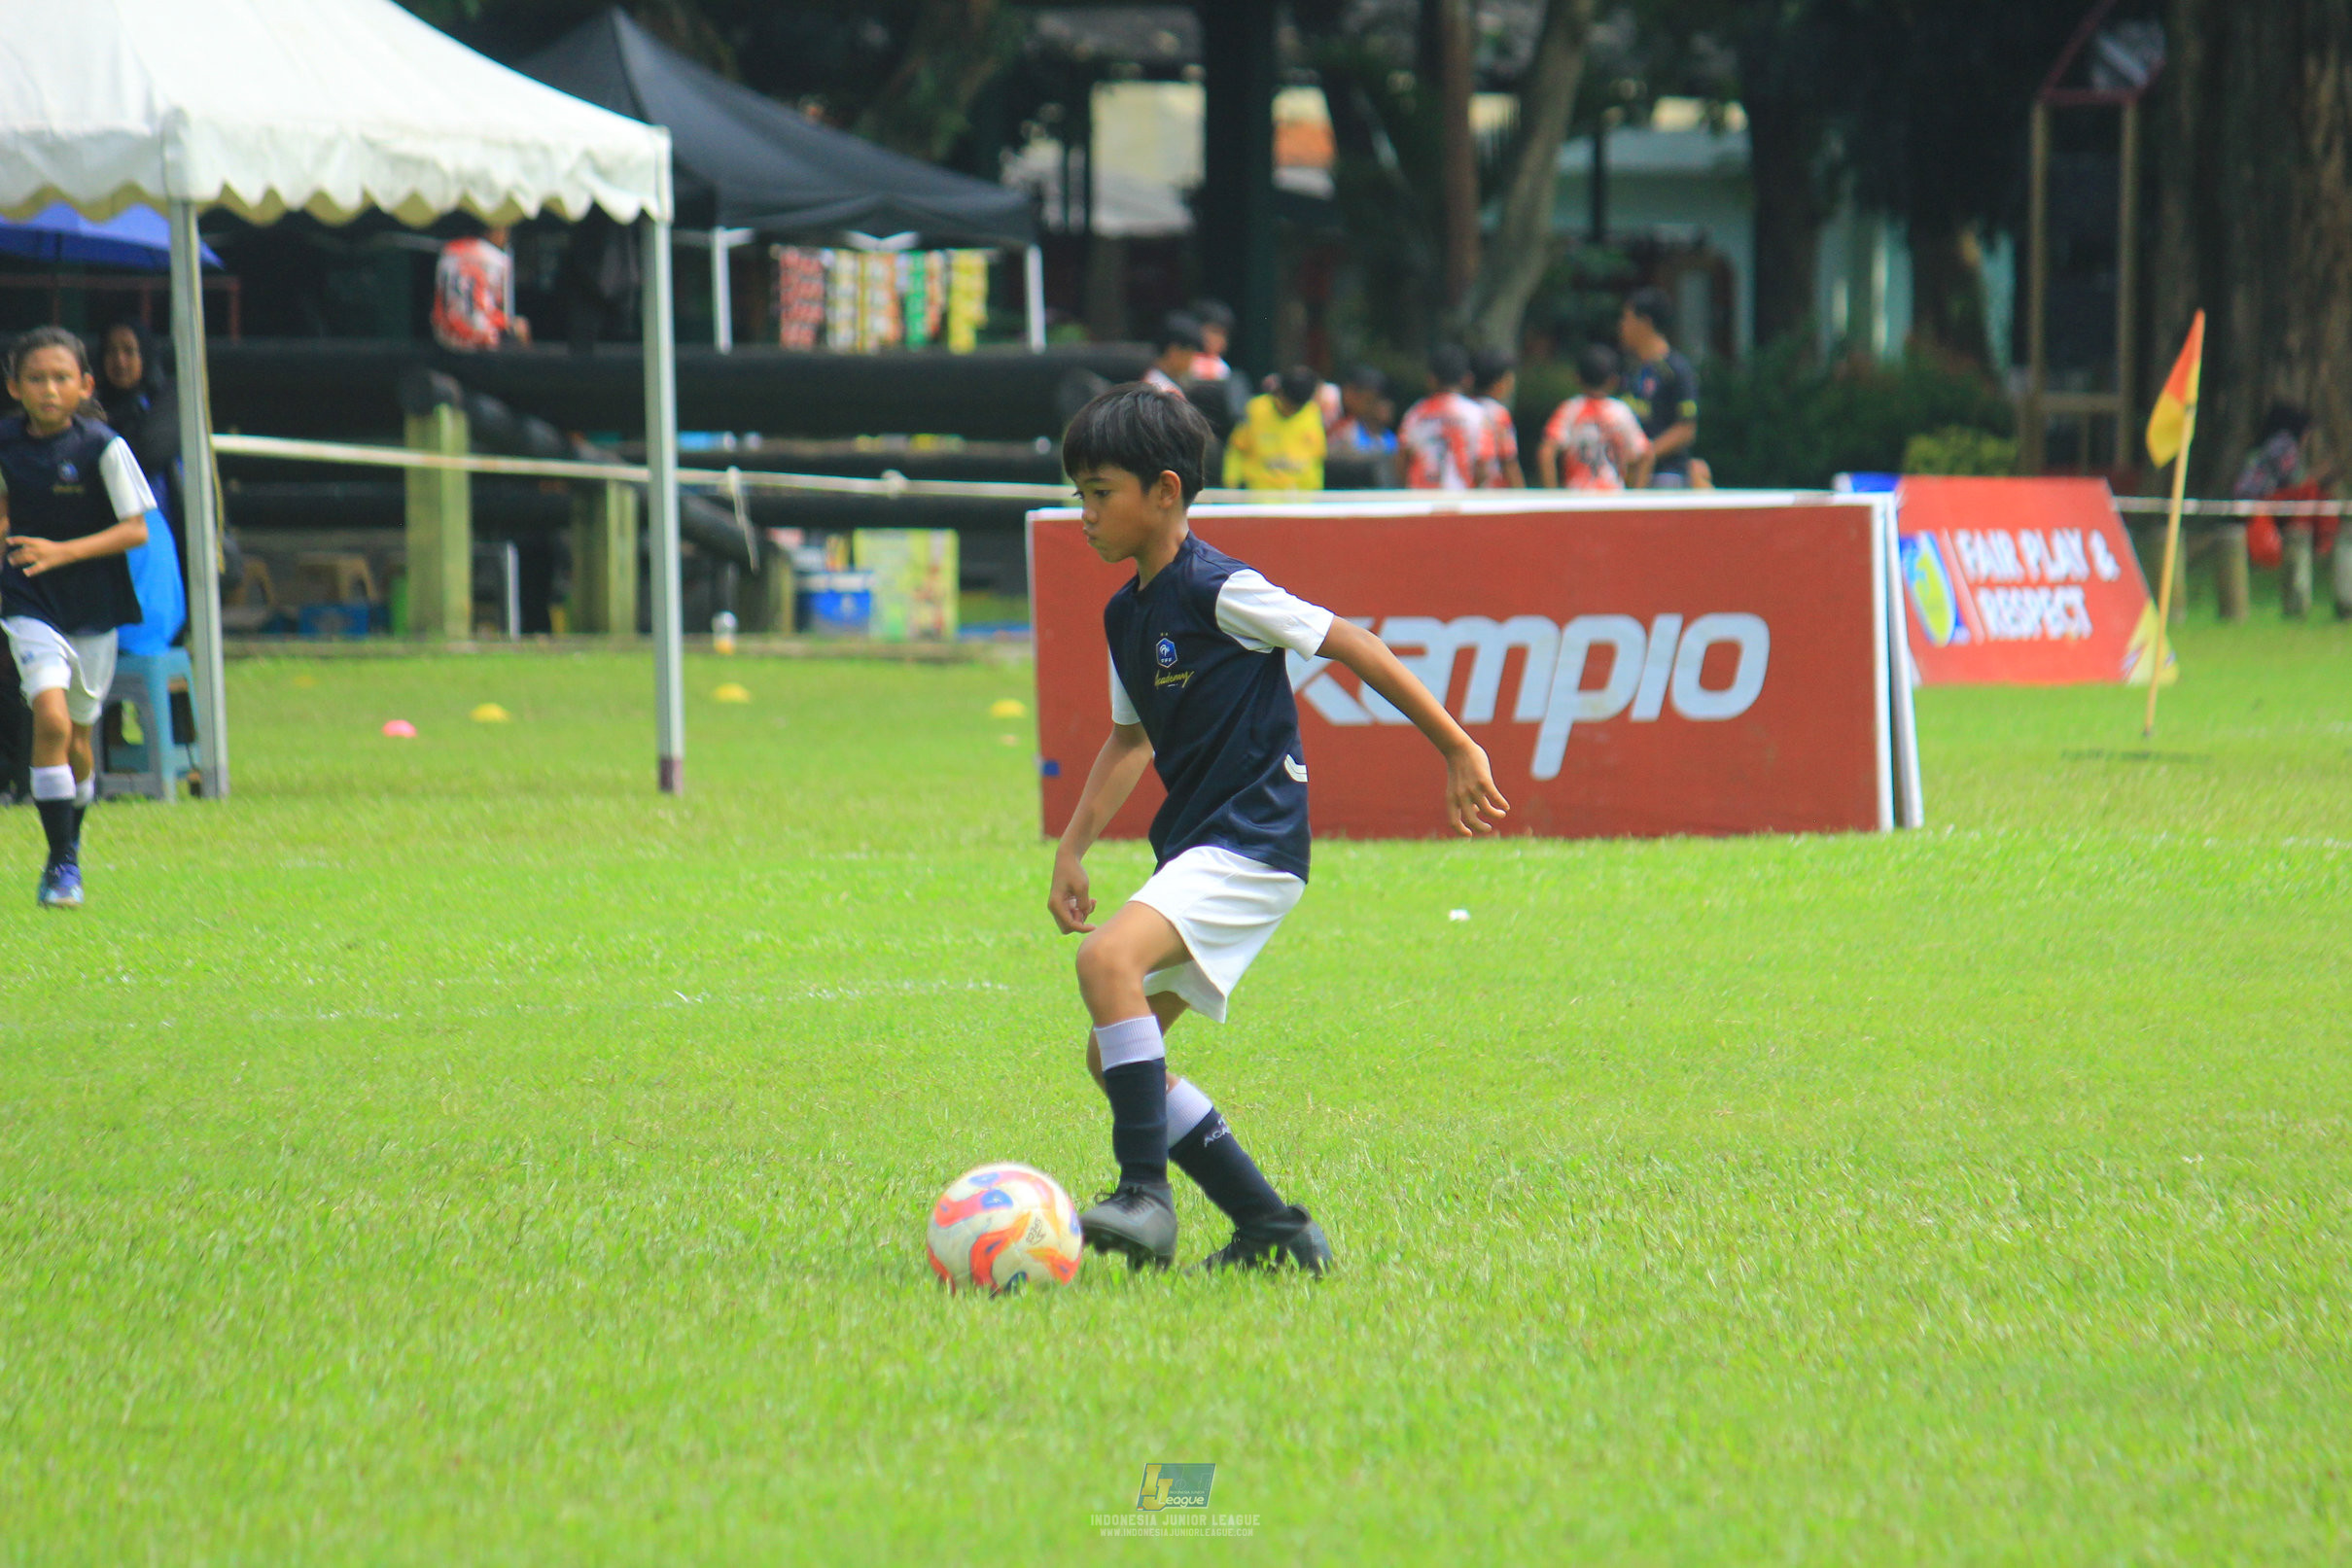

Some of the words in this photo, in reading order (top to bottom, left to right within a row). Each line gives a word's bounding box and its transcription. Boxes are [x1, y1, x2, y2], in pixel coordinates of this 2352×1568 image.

[1954, 528, 2025, 583] FAIR
[2019, 527, 2090, 583] PLAY
[2089, 529, 2122, 583] &
[1976, 585, 2093, 642] RESPECT
